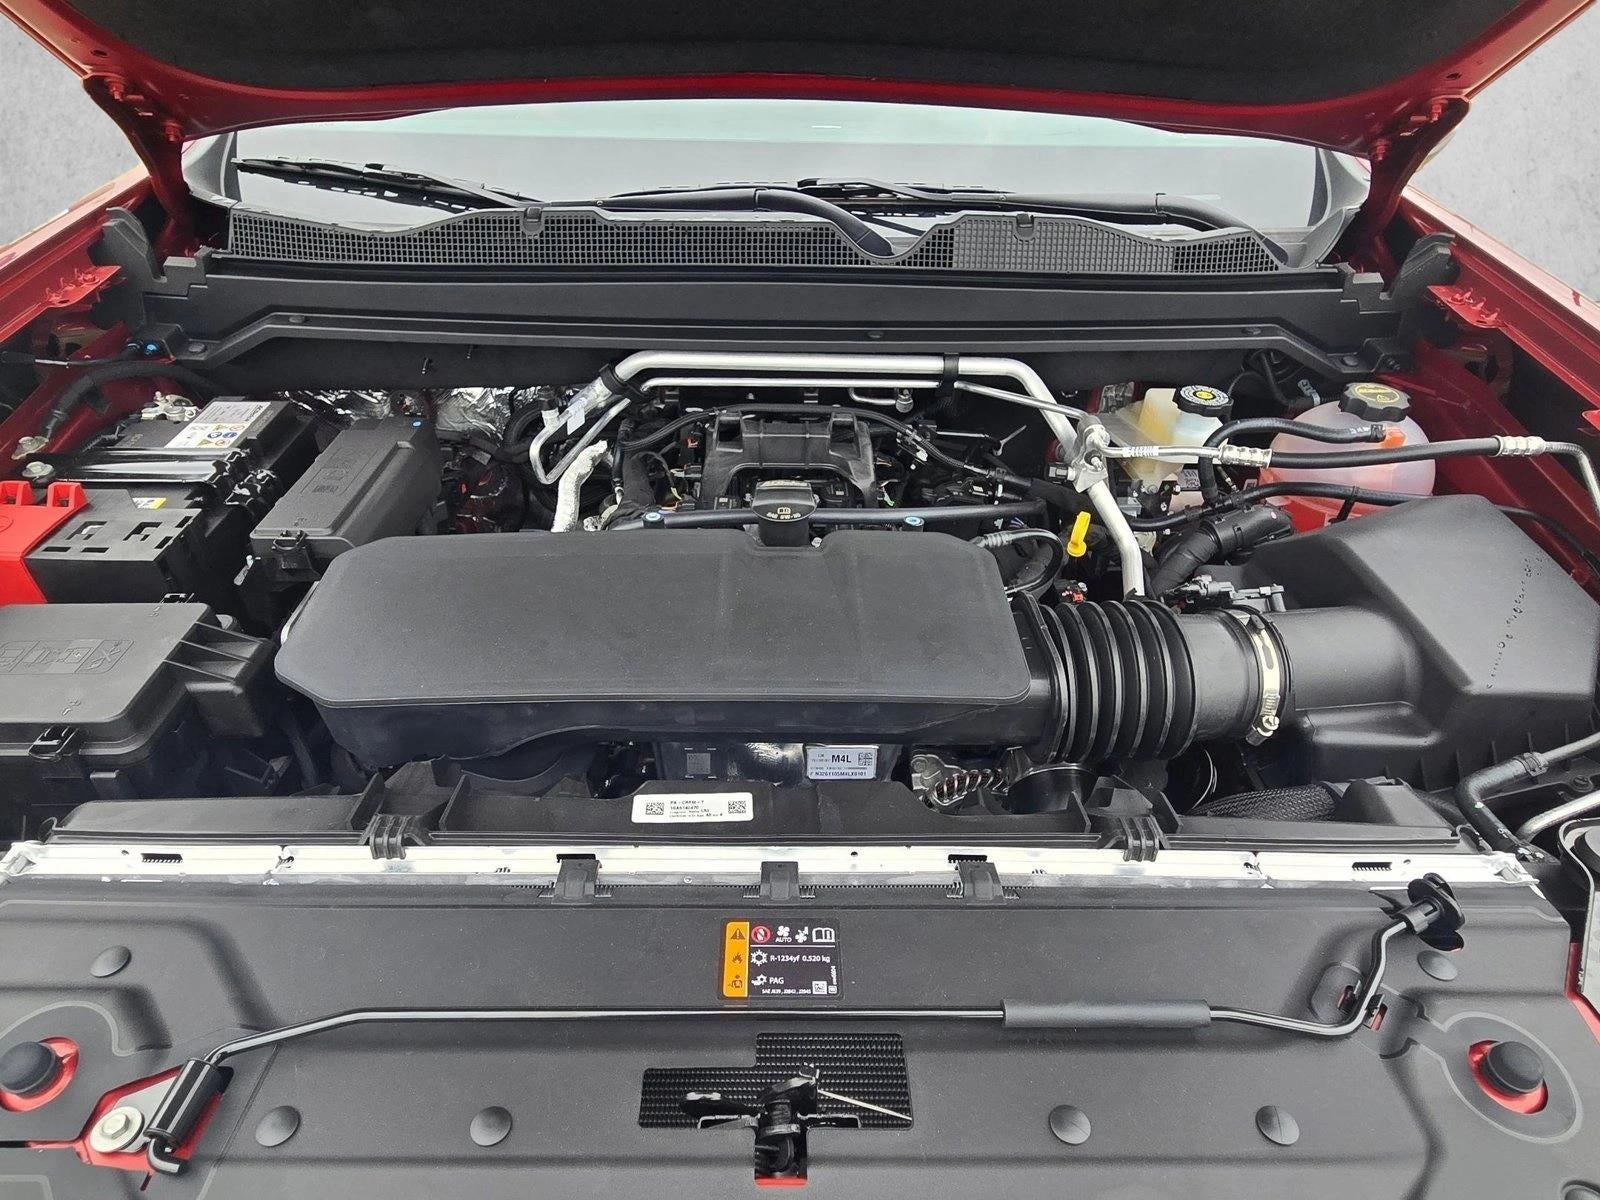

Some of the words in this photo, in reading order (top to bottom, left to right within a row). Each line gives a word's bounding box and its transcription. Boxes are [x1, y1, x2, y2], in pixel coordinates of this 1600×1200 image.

[832, 754, 851, 763] M4L
[770, 955, 800, 963] R-1234yf
[822, 955, 831, 963] kg
